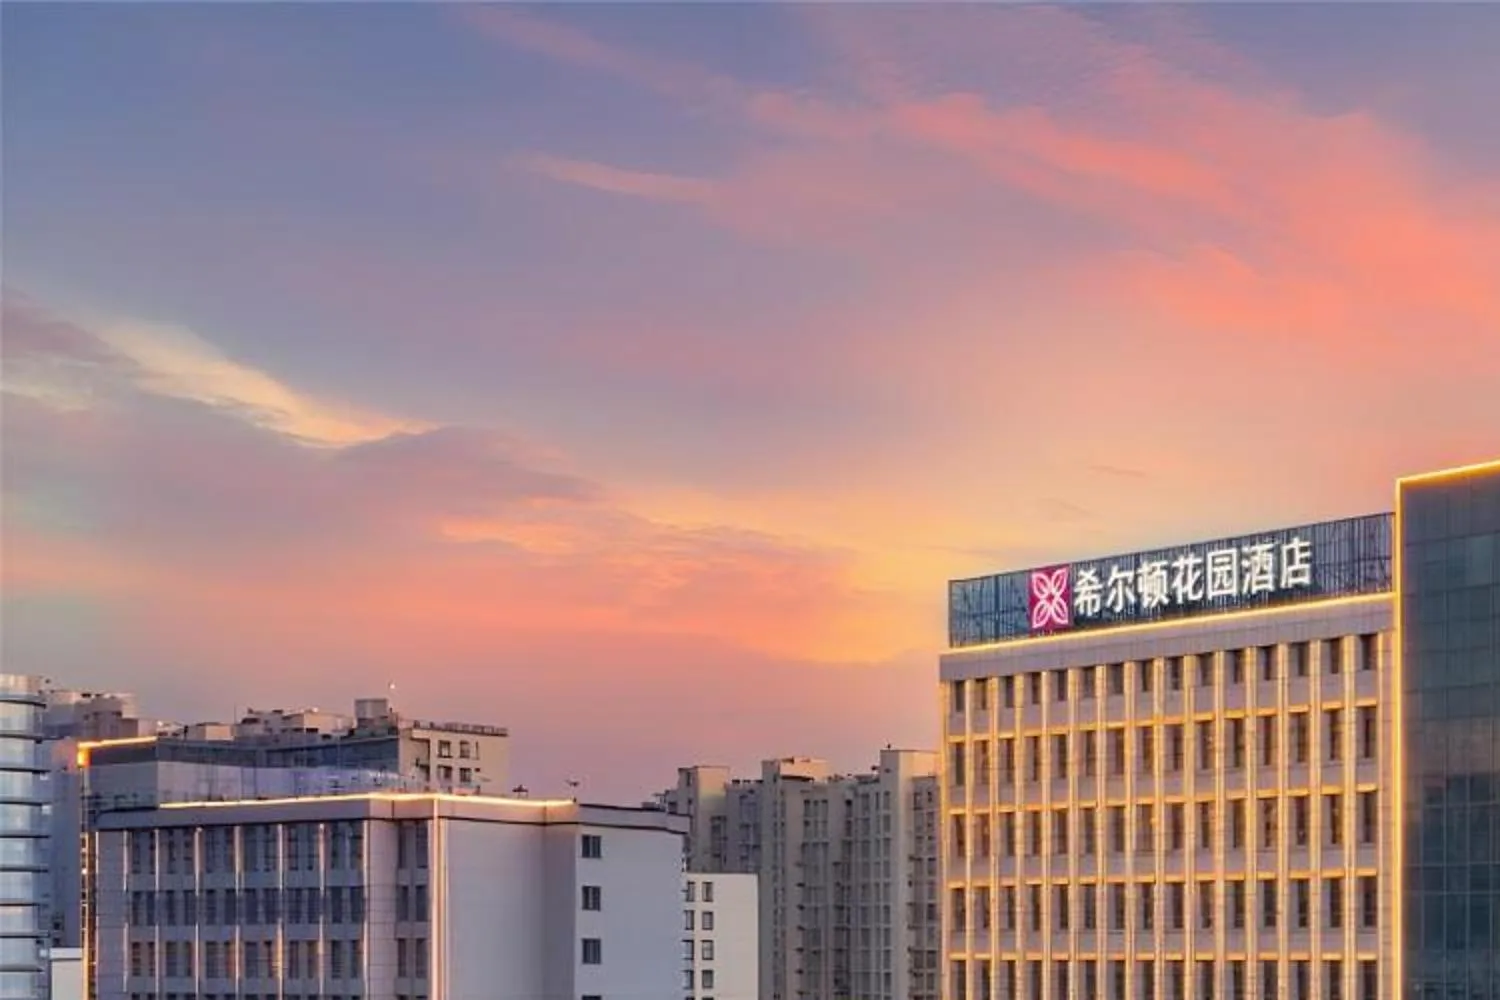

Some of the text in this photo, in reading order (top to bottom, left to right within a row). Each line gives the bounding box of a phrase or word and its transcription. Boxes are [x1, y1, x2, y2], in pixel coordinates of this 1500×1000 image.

[1074, 537, 1313, 616] 希尔顿花园酒店
